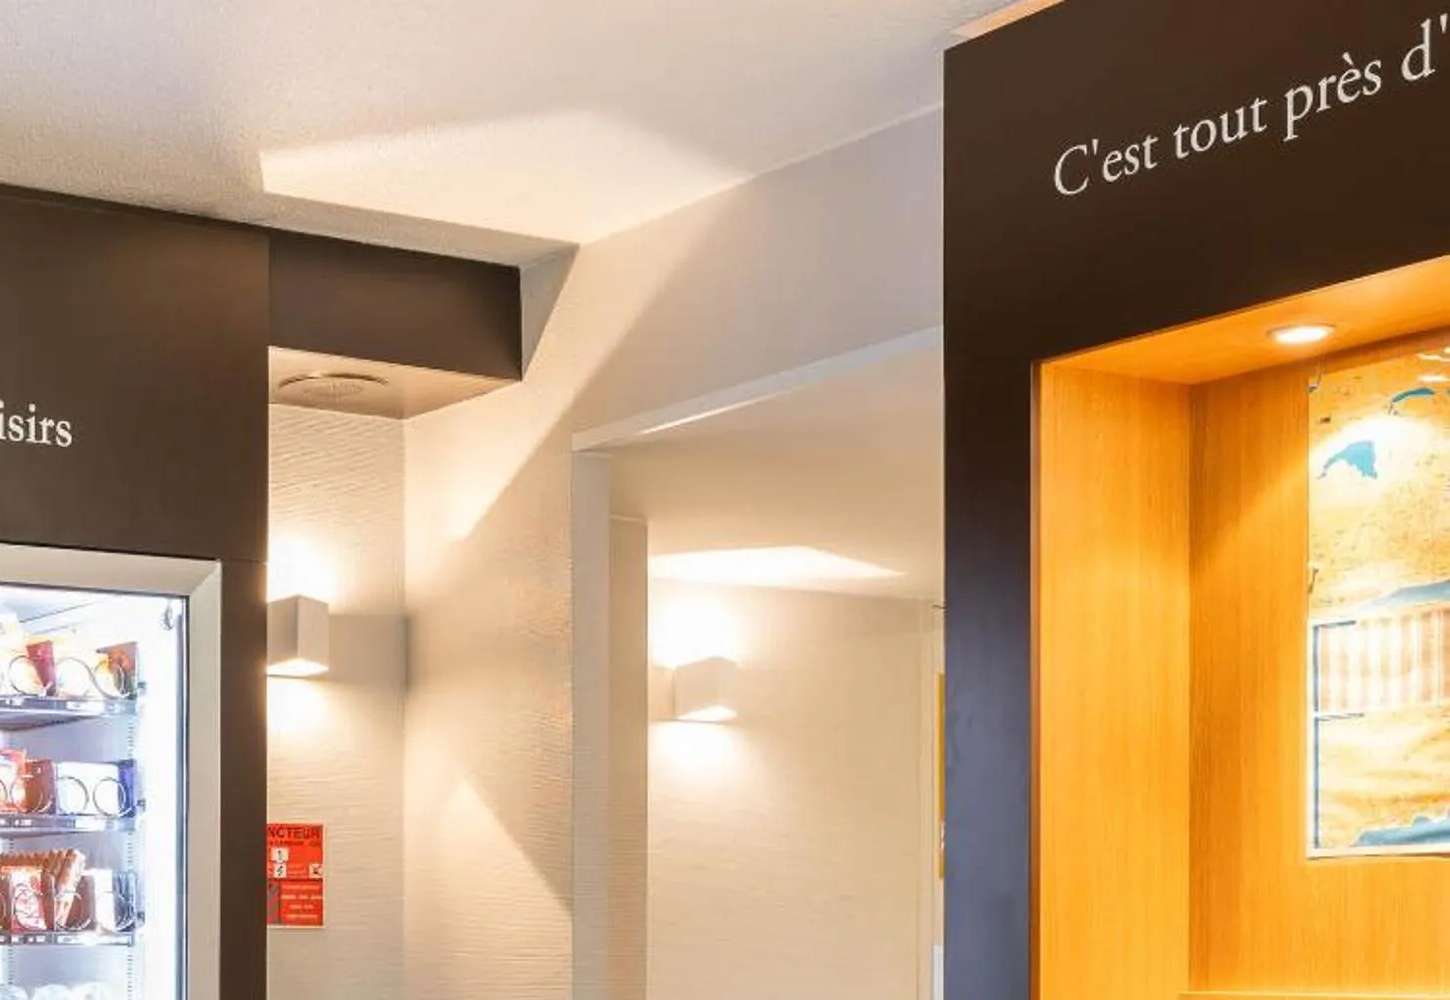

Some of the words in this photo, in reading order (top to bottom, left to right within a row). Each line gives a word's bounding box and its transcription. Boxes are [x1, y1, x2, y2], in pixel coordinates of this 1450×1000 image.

[1054, 135, 1158, 195] C'est
[1173, 97, 1268, 159] tout
[1283, 52, 1382, 142] près
